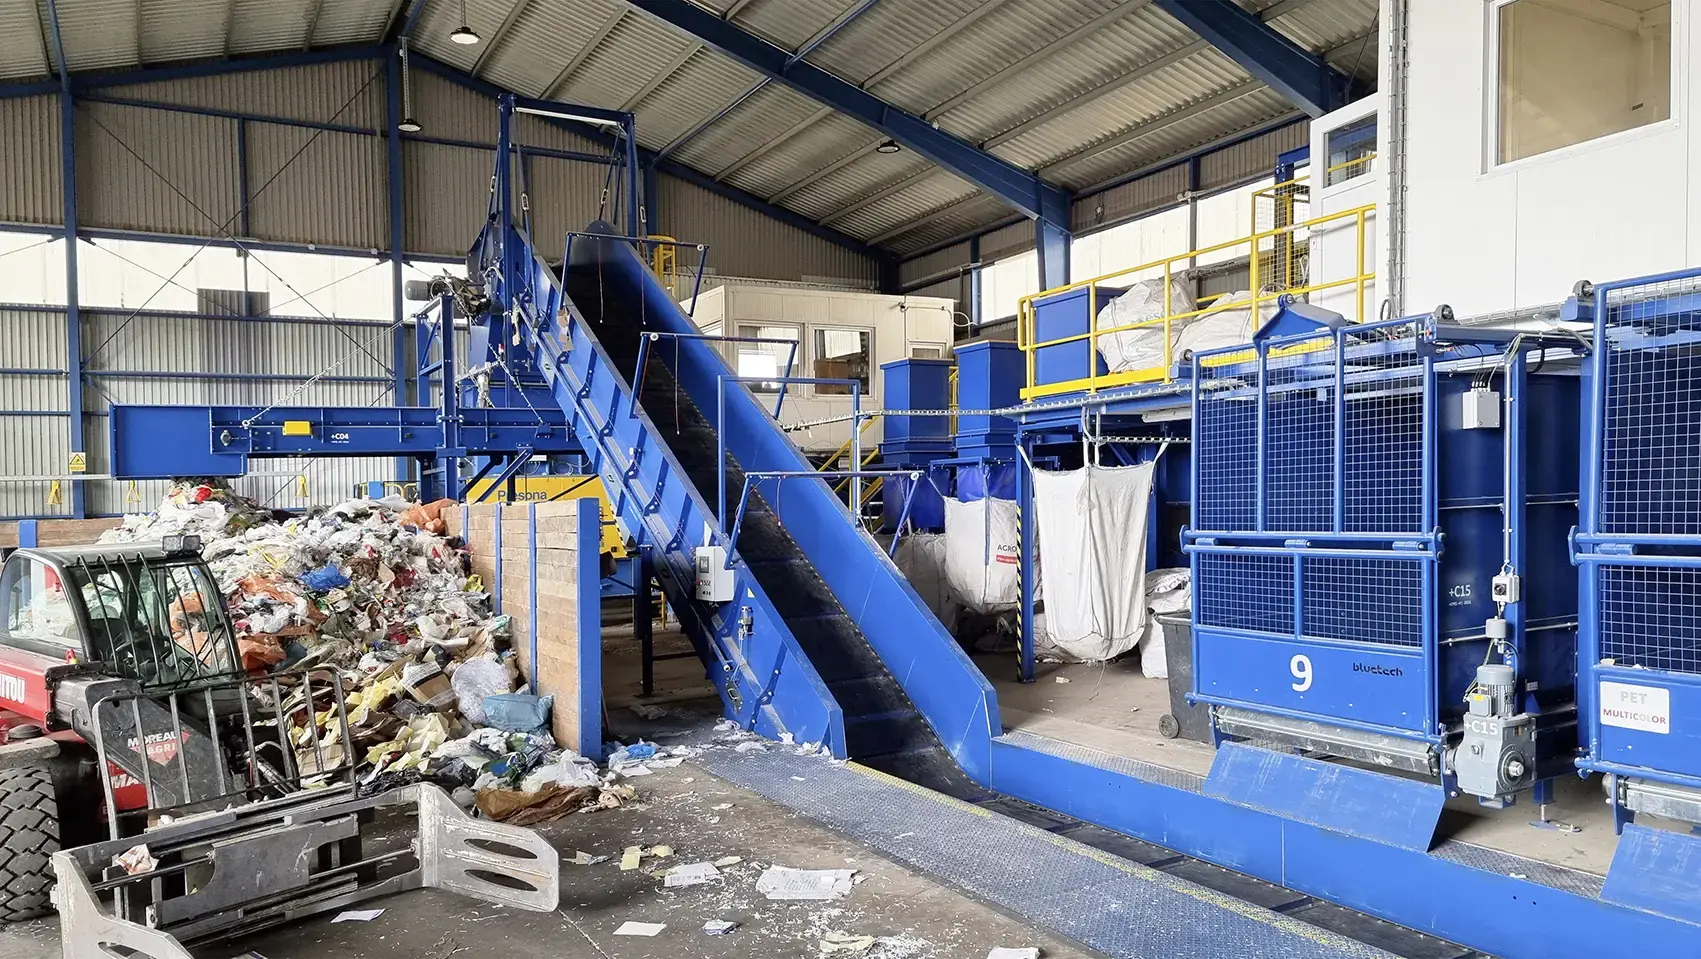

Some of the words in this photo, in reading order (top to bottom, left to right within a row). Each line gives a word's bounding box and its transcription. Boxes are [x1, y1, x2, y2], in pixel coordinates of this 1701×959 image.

[498, 490, 547, 501] Psona
[1449, 585, 1471, 597] +C15
[1290, 654, 1313, 692] 9
[1352, 662, 1403, 677] bluetech
[1621, 691, 1647, 705] PET
[1603, 708, 1667, 725] MULTICOLOR
[1464, 720, 1498, 735] +C15
[146, 742, 176, 755] AGRI
